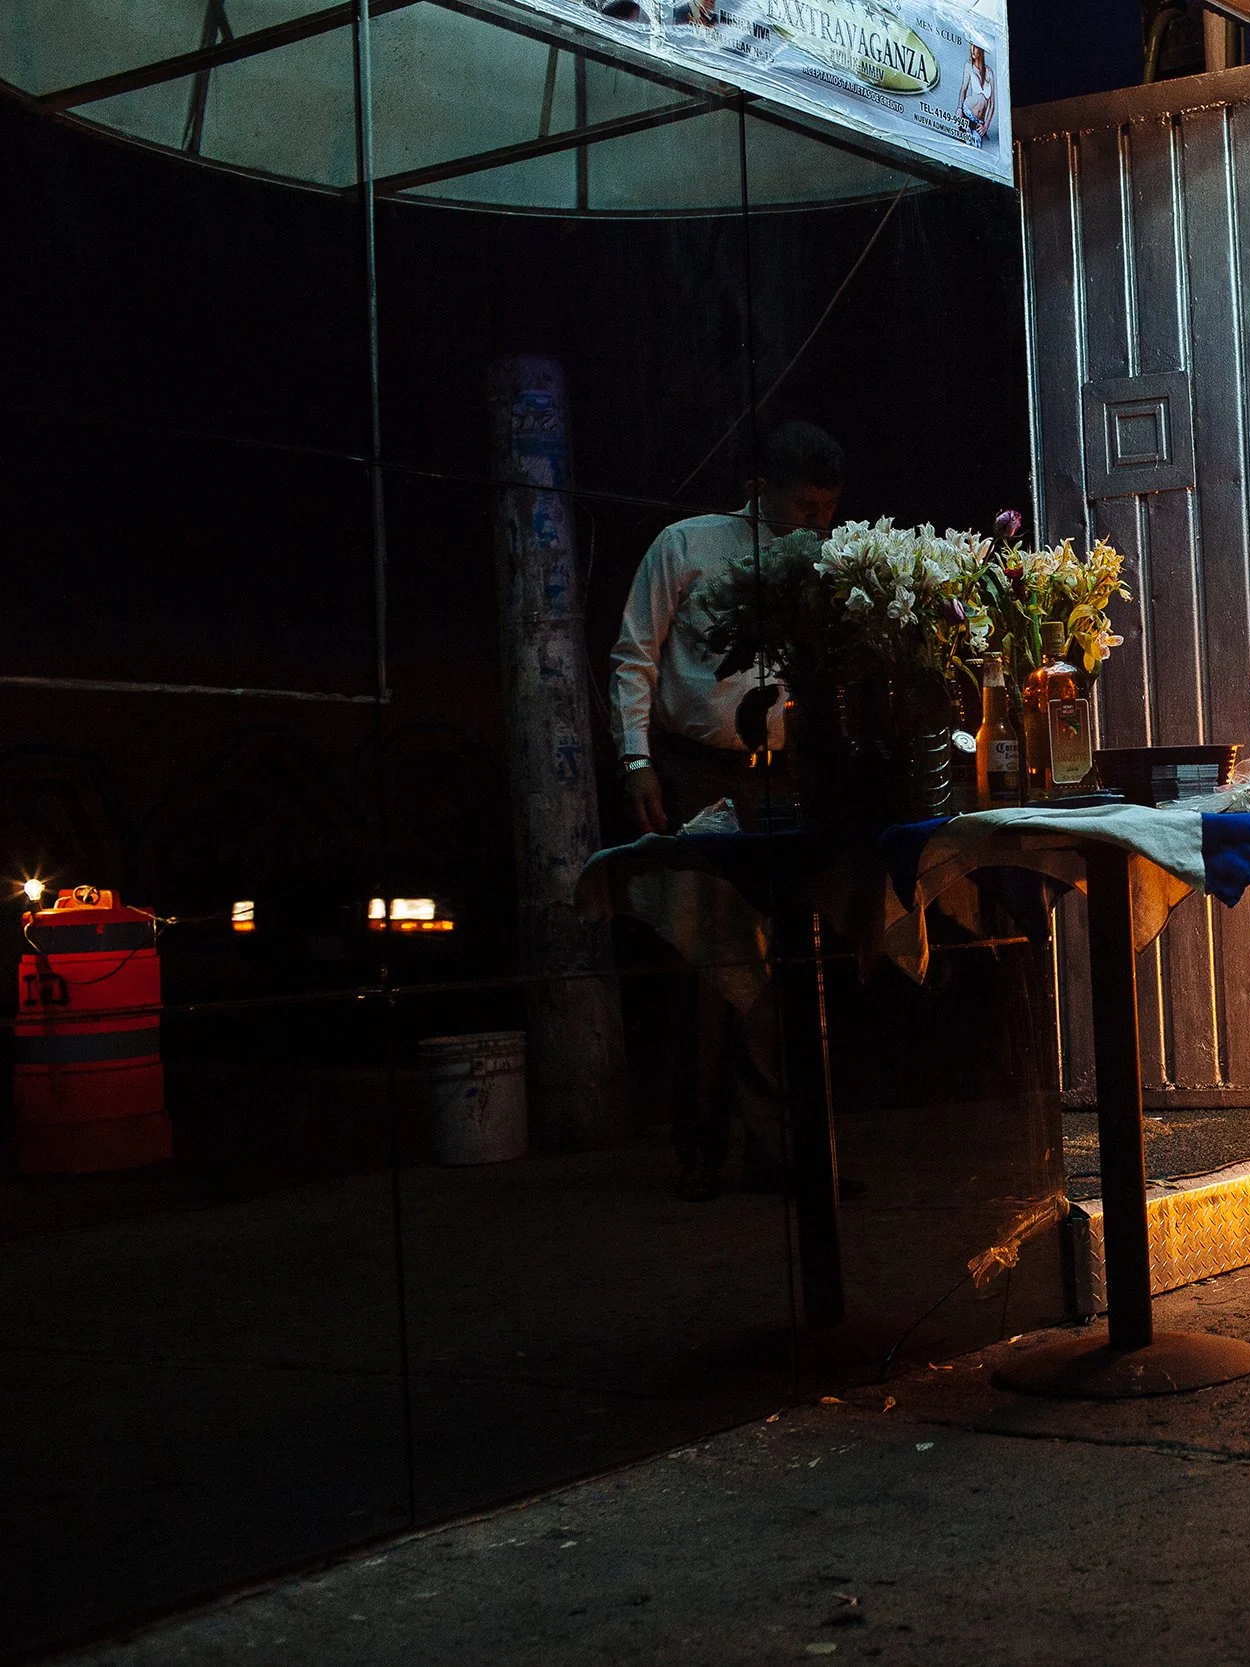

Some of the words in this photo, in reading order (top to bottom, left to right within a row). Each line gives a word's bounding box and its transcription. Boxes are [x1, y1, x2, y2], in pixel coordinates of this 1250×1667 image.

[752, 22, 771, 42] VIVA
[941, 29, 963, 46] CLUB
[802, 66, 842, 88] ACEPTAMOS
[842, 79, 872, 101] TARJETAS
[880, 95, 905, 115] CREDITO
[920, 101, 935, 116] TEL:
[913, 113, 933, 127] NUEVA
